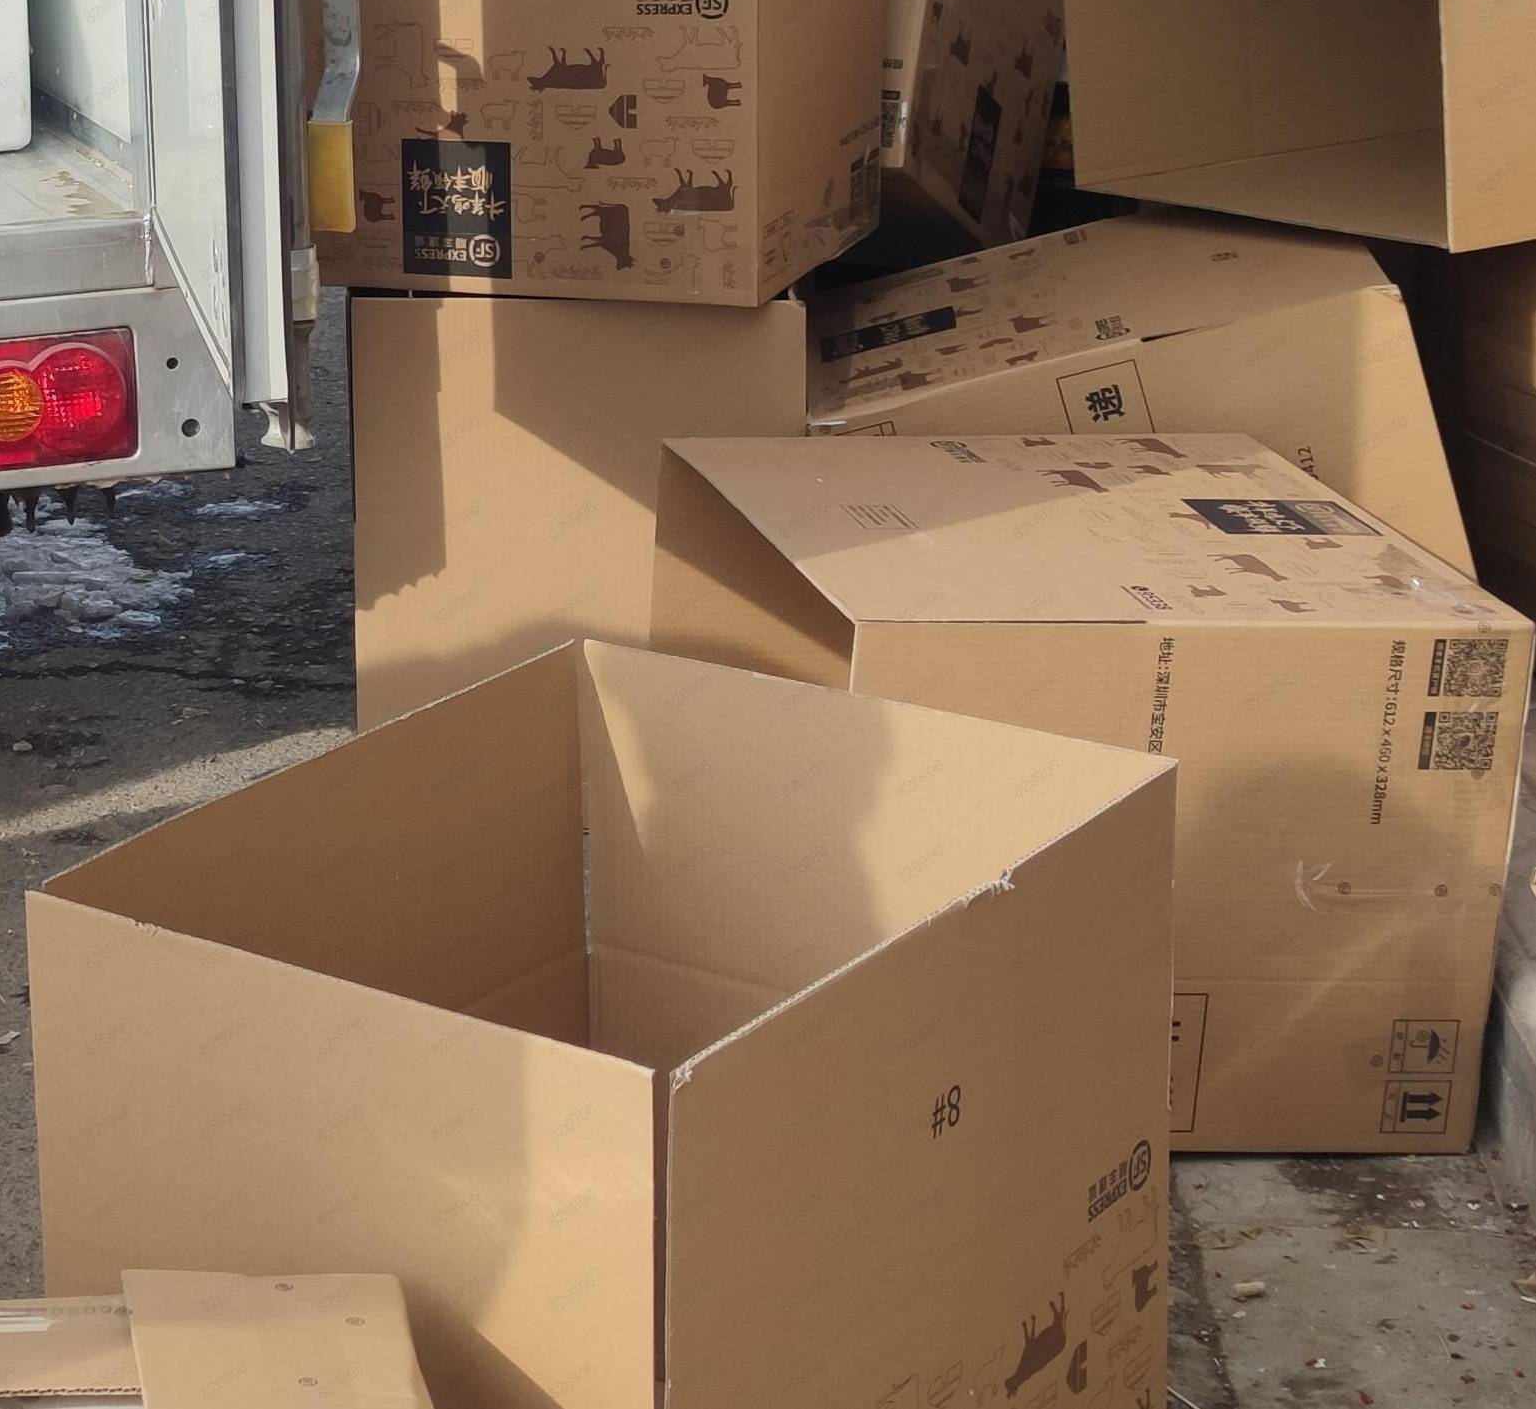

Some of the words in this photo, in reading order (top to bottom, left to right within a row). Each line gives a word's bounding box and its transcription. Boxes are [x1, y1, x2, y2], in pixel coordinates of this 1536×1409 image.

[636, 3, 693, 15] EXPRESS
[406, 160, 494, 193] 顺丰领鲜
[418, 190, 507, 222] 牛羊鸣天下
[414, 247, 468, 262] EXPRESS
[1084, 383, 1126, 422] 递
[1148, 636, 1176, 754] 地址:深圳市宝安区
[1381, 639, 1407, 727] 规格尺寸:612
[1370, 775, 1388, 826] 328mm
